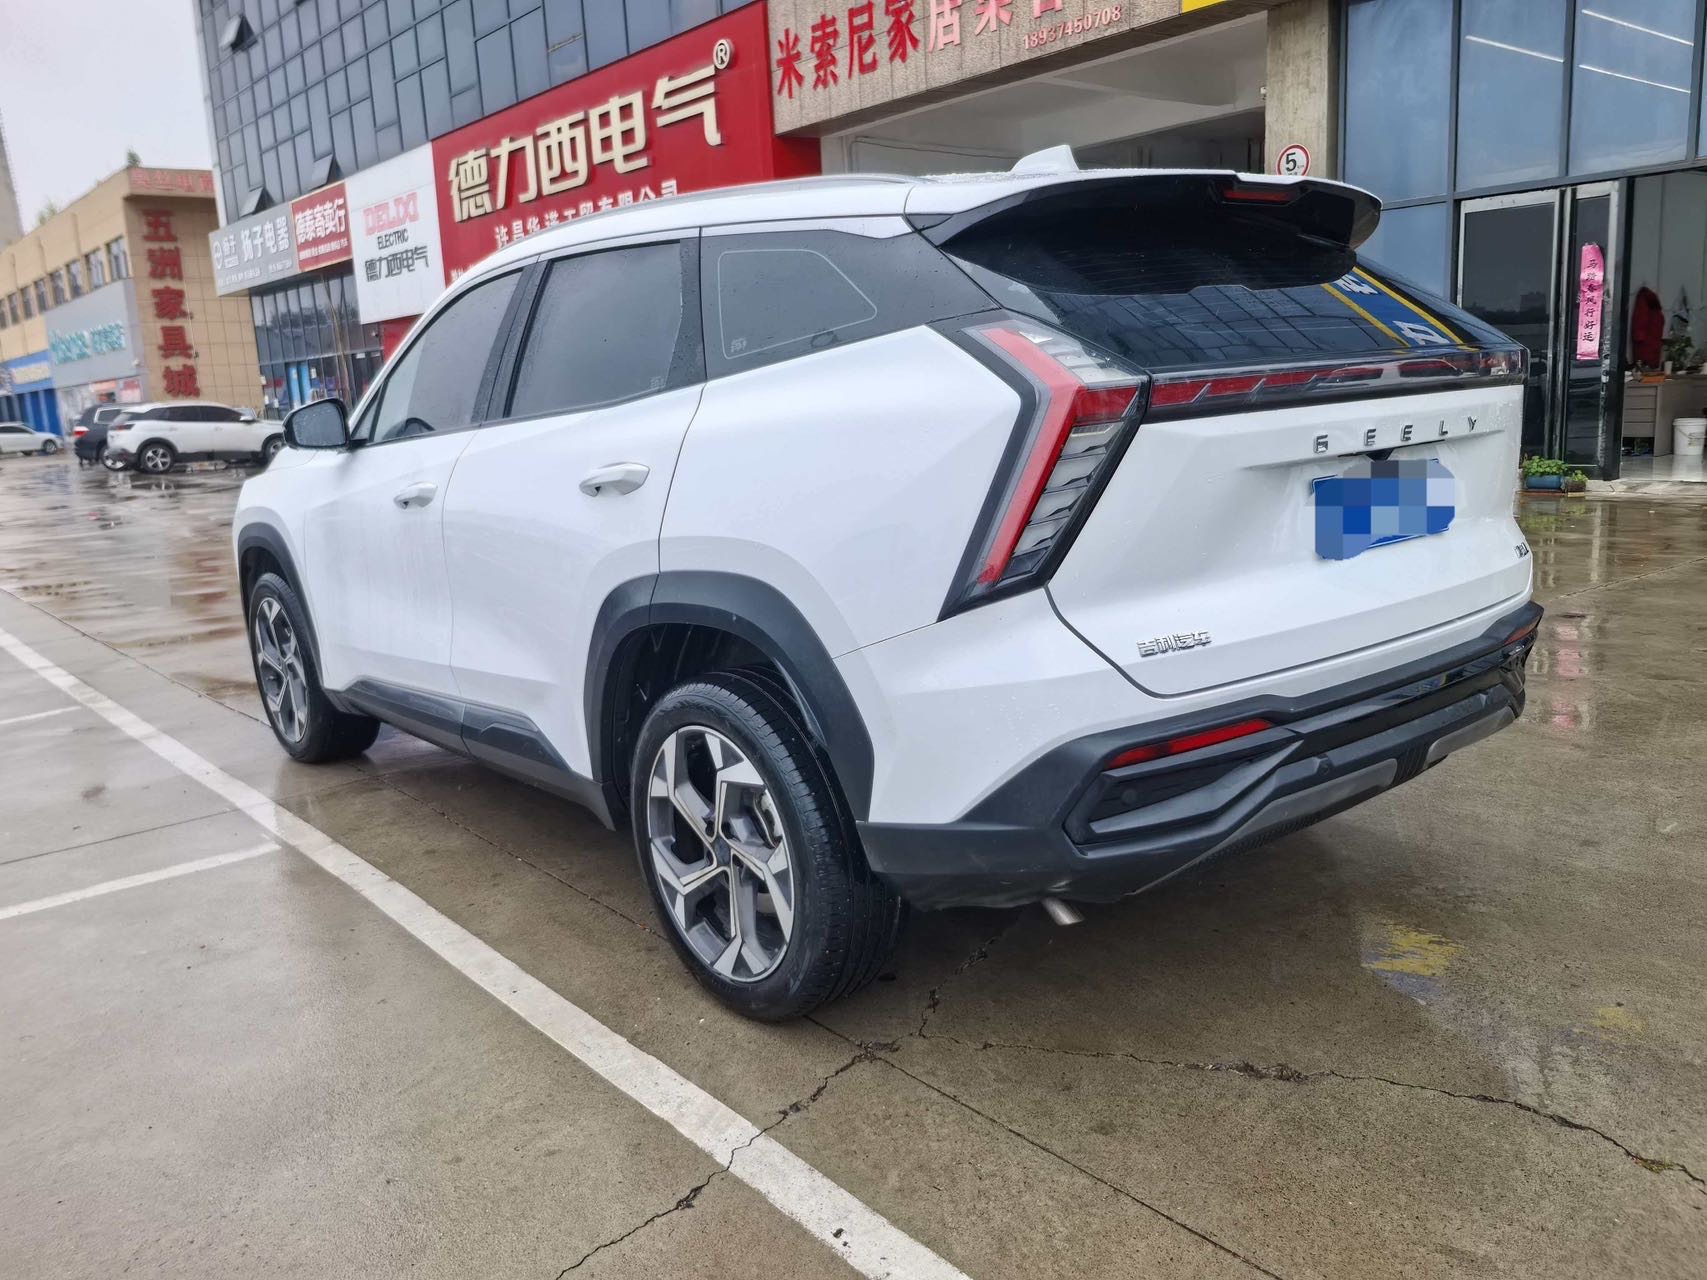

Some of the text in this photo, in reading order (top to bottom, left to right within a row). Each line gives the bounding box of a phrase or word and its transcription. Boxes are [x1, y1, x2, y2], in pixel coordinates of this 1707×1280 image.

[1022, 5, 1123, 50] 18937450708
[447, 64, 722, 223] 德力西电气
[1286, 152, 1297, 172] 5
[363, 191, 420, 237] DELIXI
[377, 228, 410, 251] ELECTRIC
[364, 245, 430, 283] 德力西电气
[142, 208, 201, 398] 五洲家具城
[1312, 415, 1479, 454] GEELY
[1136, 631, 1213, 659] 吉利汽车
